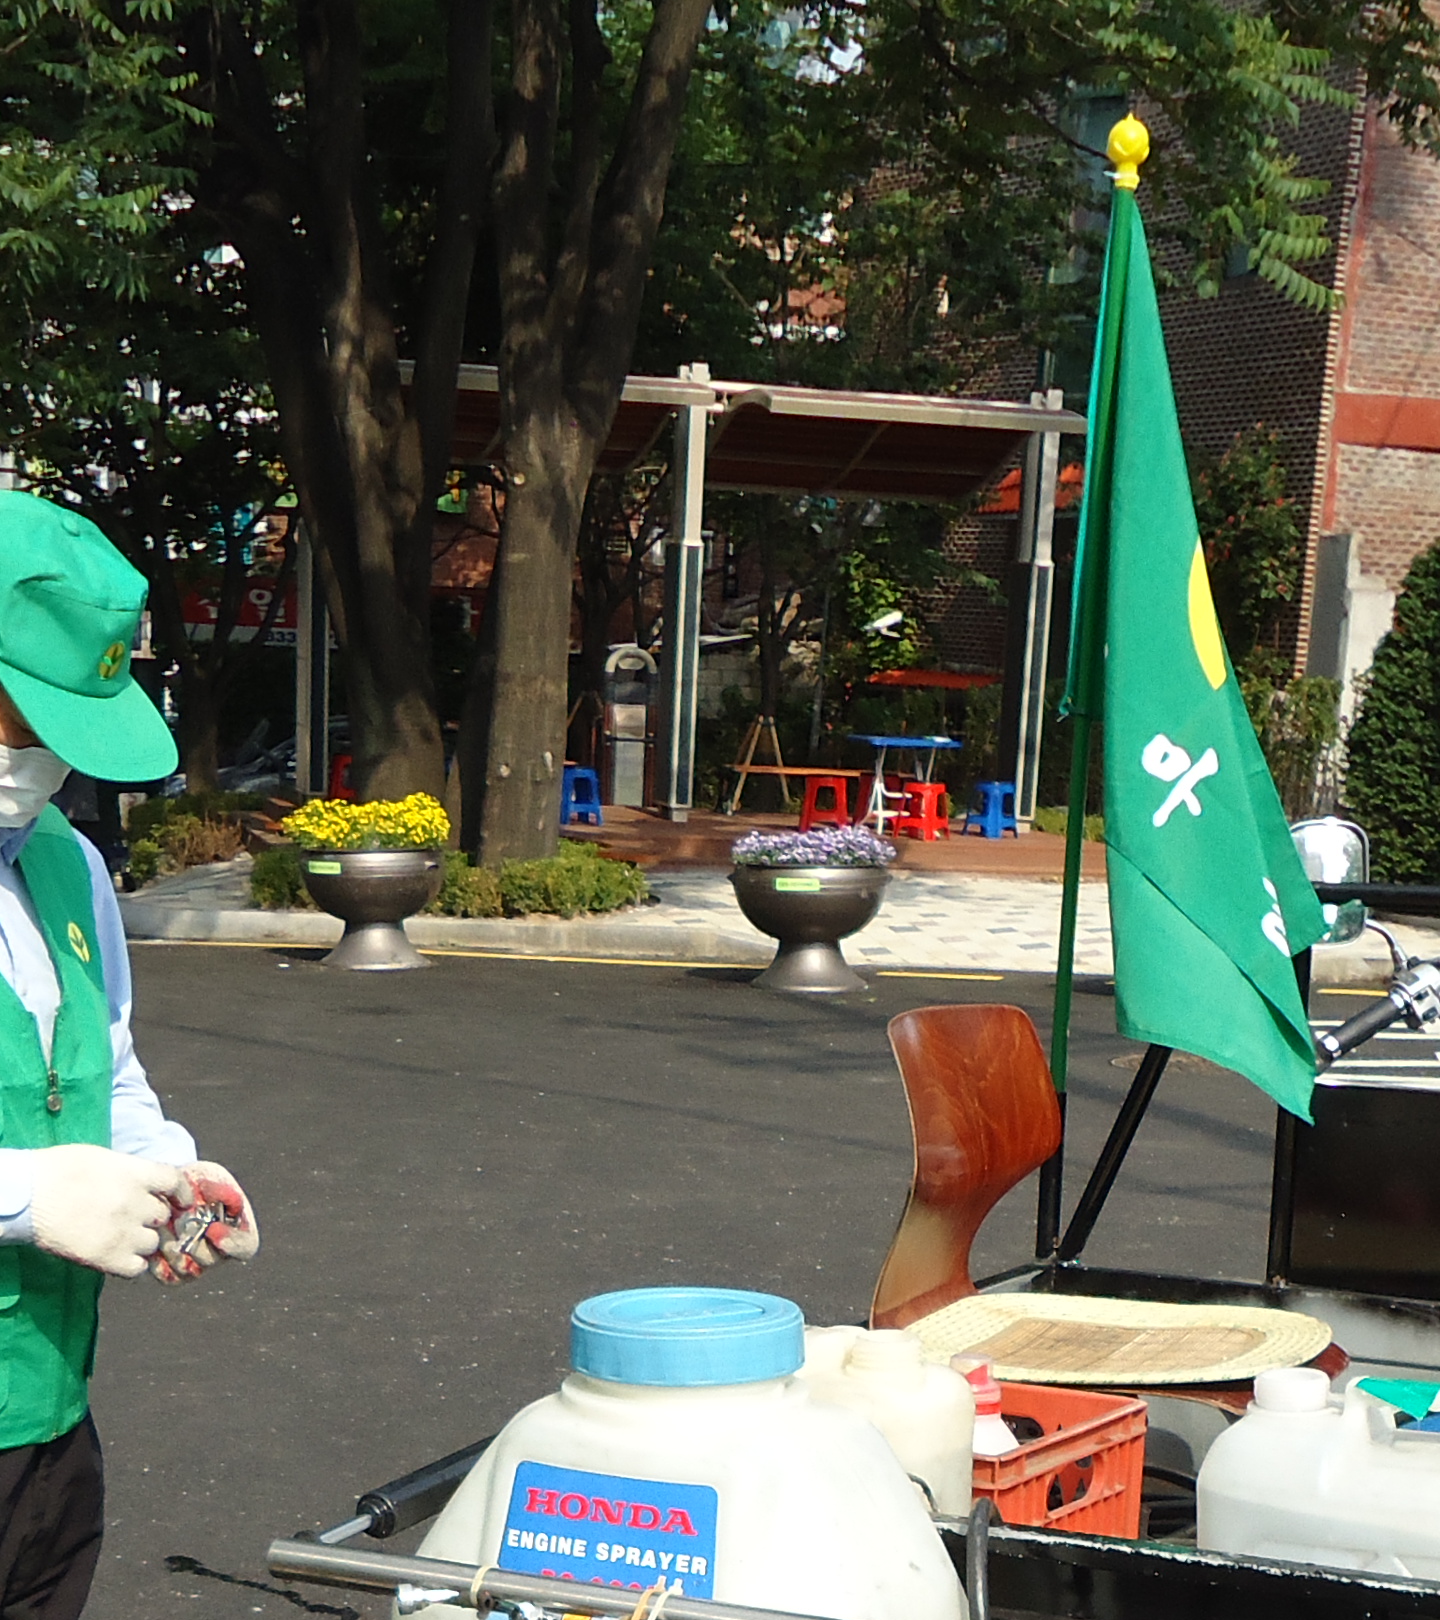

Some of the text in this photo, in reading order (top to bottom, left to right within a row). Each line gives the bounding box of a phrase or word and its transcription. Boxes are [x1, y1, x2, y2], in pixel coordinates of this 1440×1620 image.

[525, 1487, 699, 1537] HONDA
[507, 1528, 708, 1576] ENGINE SPRAYER
